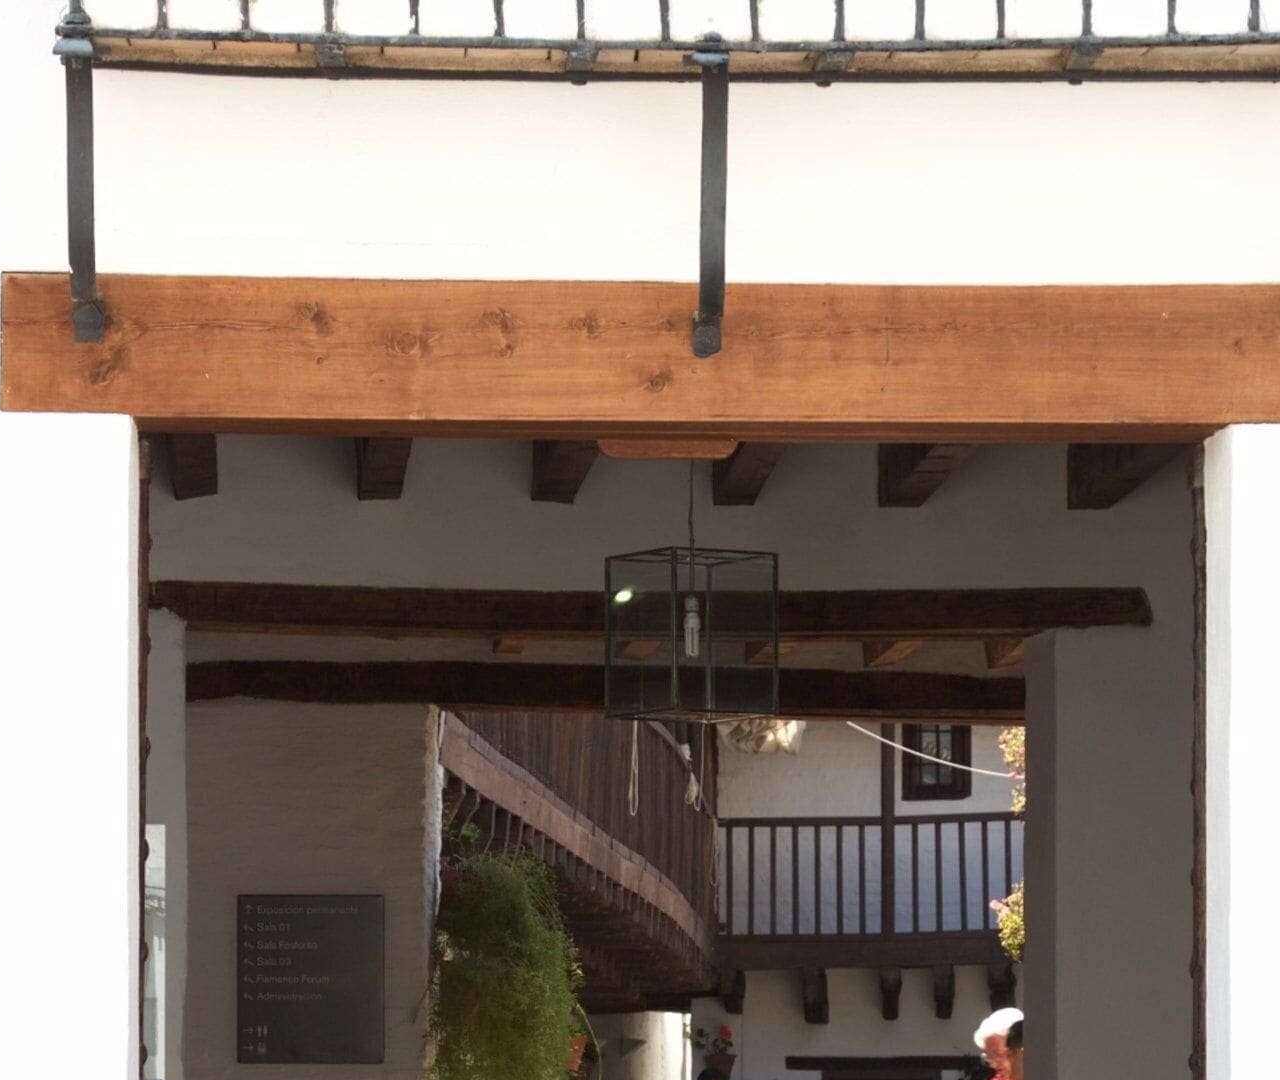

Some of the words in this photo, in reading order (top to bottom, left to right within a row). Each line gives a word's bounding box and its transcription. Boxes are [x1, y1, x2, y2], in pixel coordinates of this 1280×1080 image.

[256, 919, 277, 932] Sala
[256, 939, 277, 950] Sala
[256, 973, 298, 984] Flamenco
